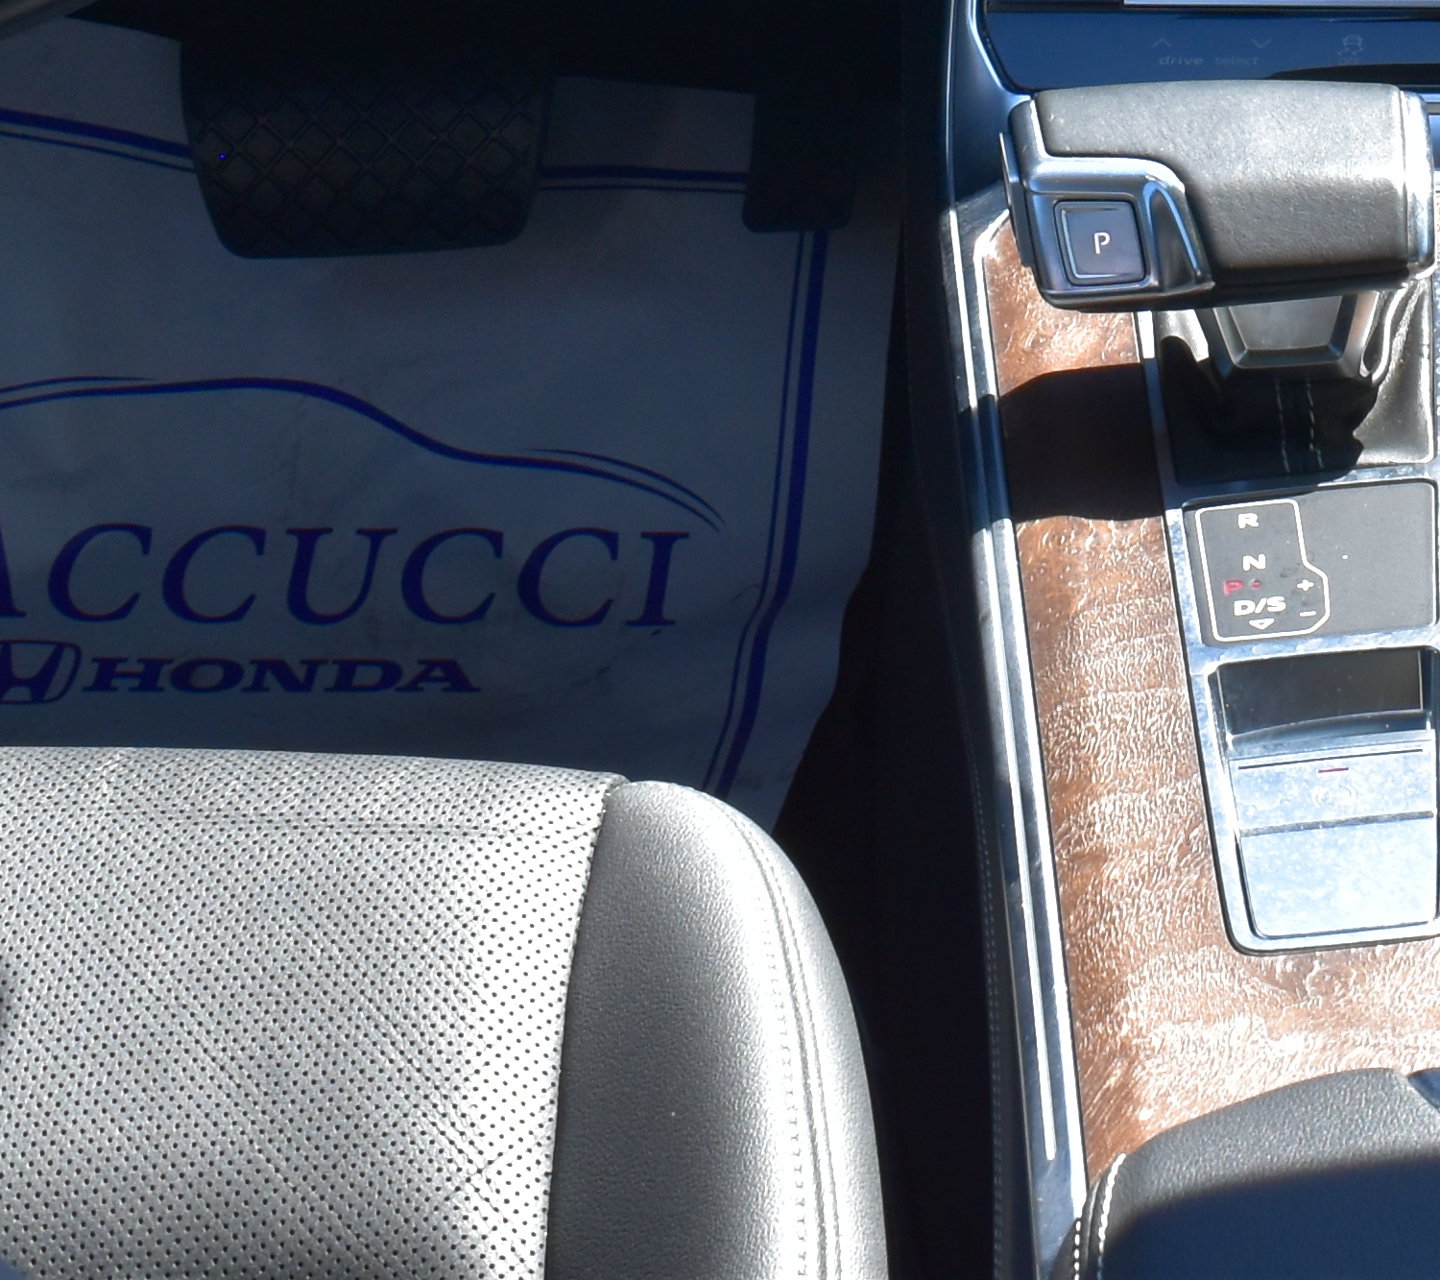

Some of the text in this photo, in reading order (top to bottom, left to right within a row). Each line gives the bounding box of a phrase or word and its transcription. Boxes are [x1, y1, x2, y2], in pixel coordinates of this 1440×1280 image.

[1159, 54, 1204, 66] drive
[1093, 232, 1111, 253] P
[1237, 512, 1260, 529] R
[1242, 553, 1266, 572] N
[1223, 579, 1245, 596] P
[1233, 595, 1287, 617] D/S
[87, 656, 480, 695] HONDA
